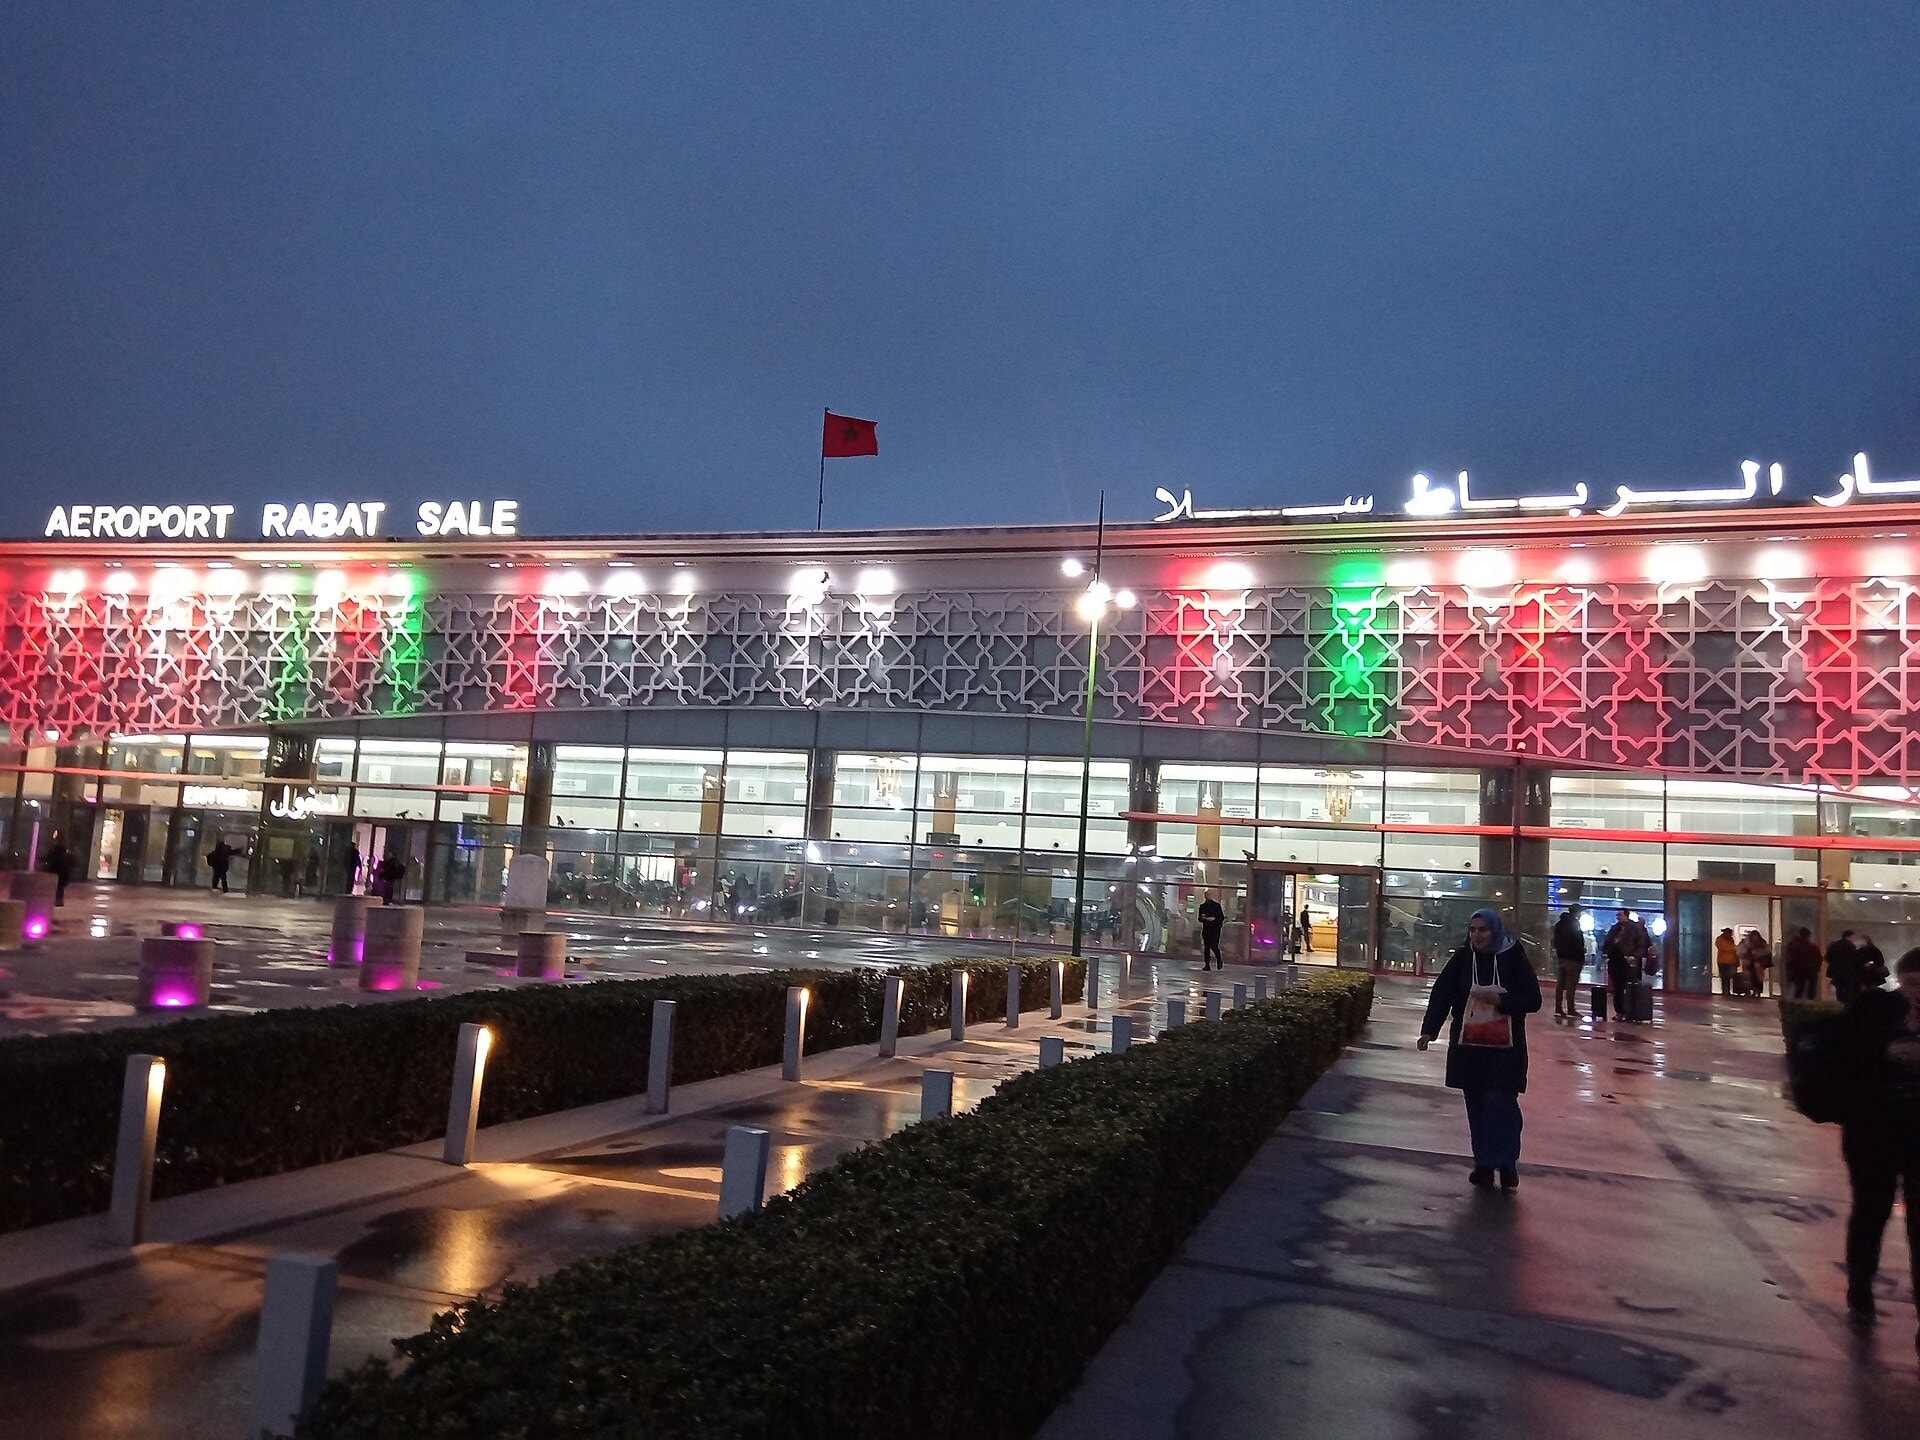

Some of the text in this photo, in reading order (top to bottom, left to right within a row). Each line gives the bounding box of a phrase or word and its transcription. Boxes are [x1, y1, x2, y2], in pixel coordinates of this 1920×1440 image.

[45, 500, 518, 538] AEROPORT RABAT SALE
[1153, 485, 1375, 522] سلا
